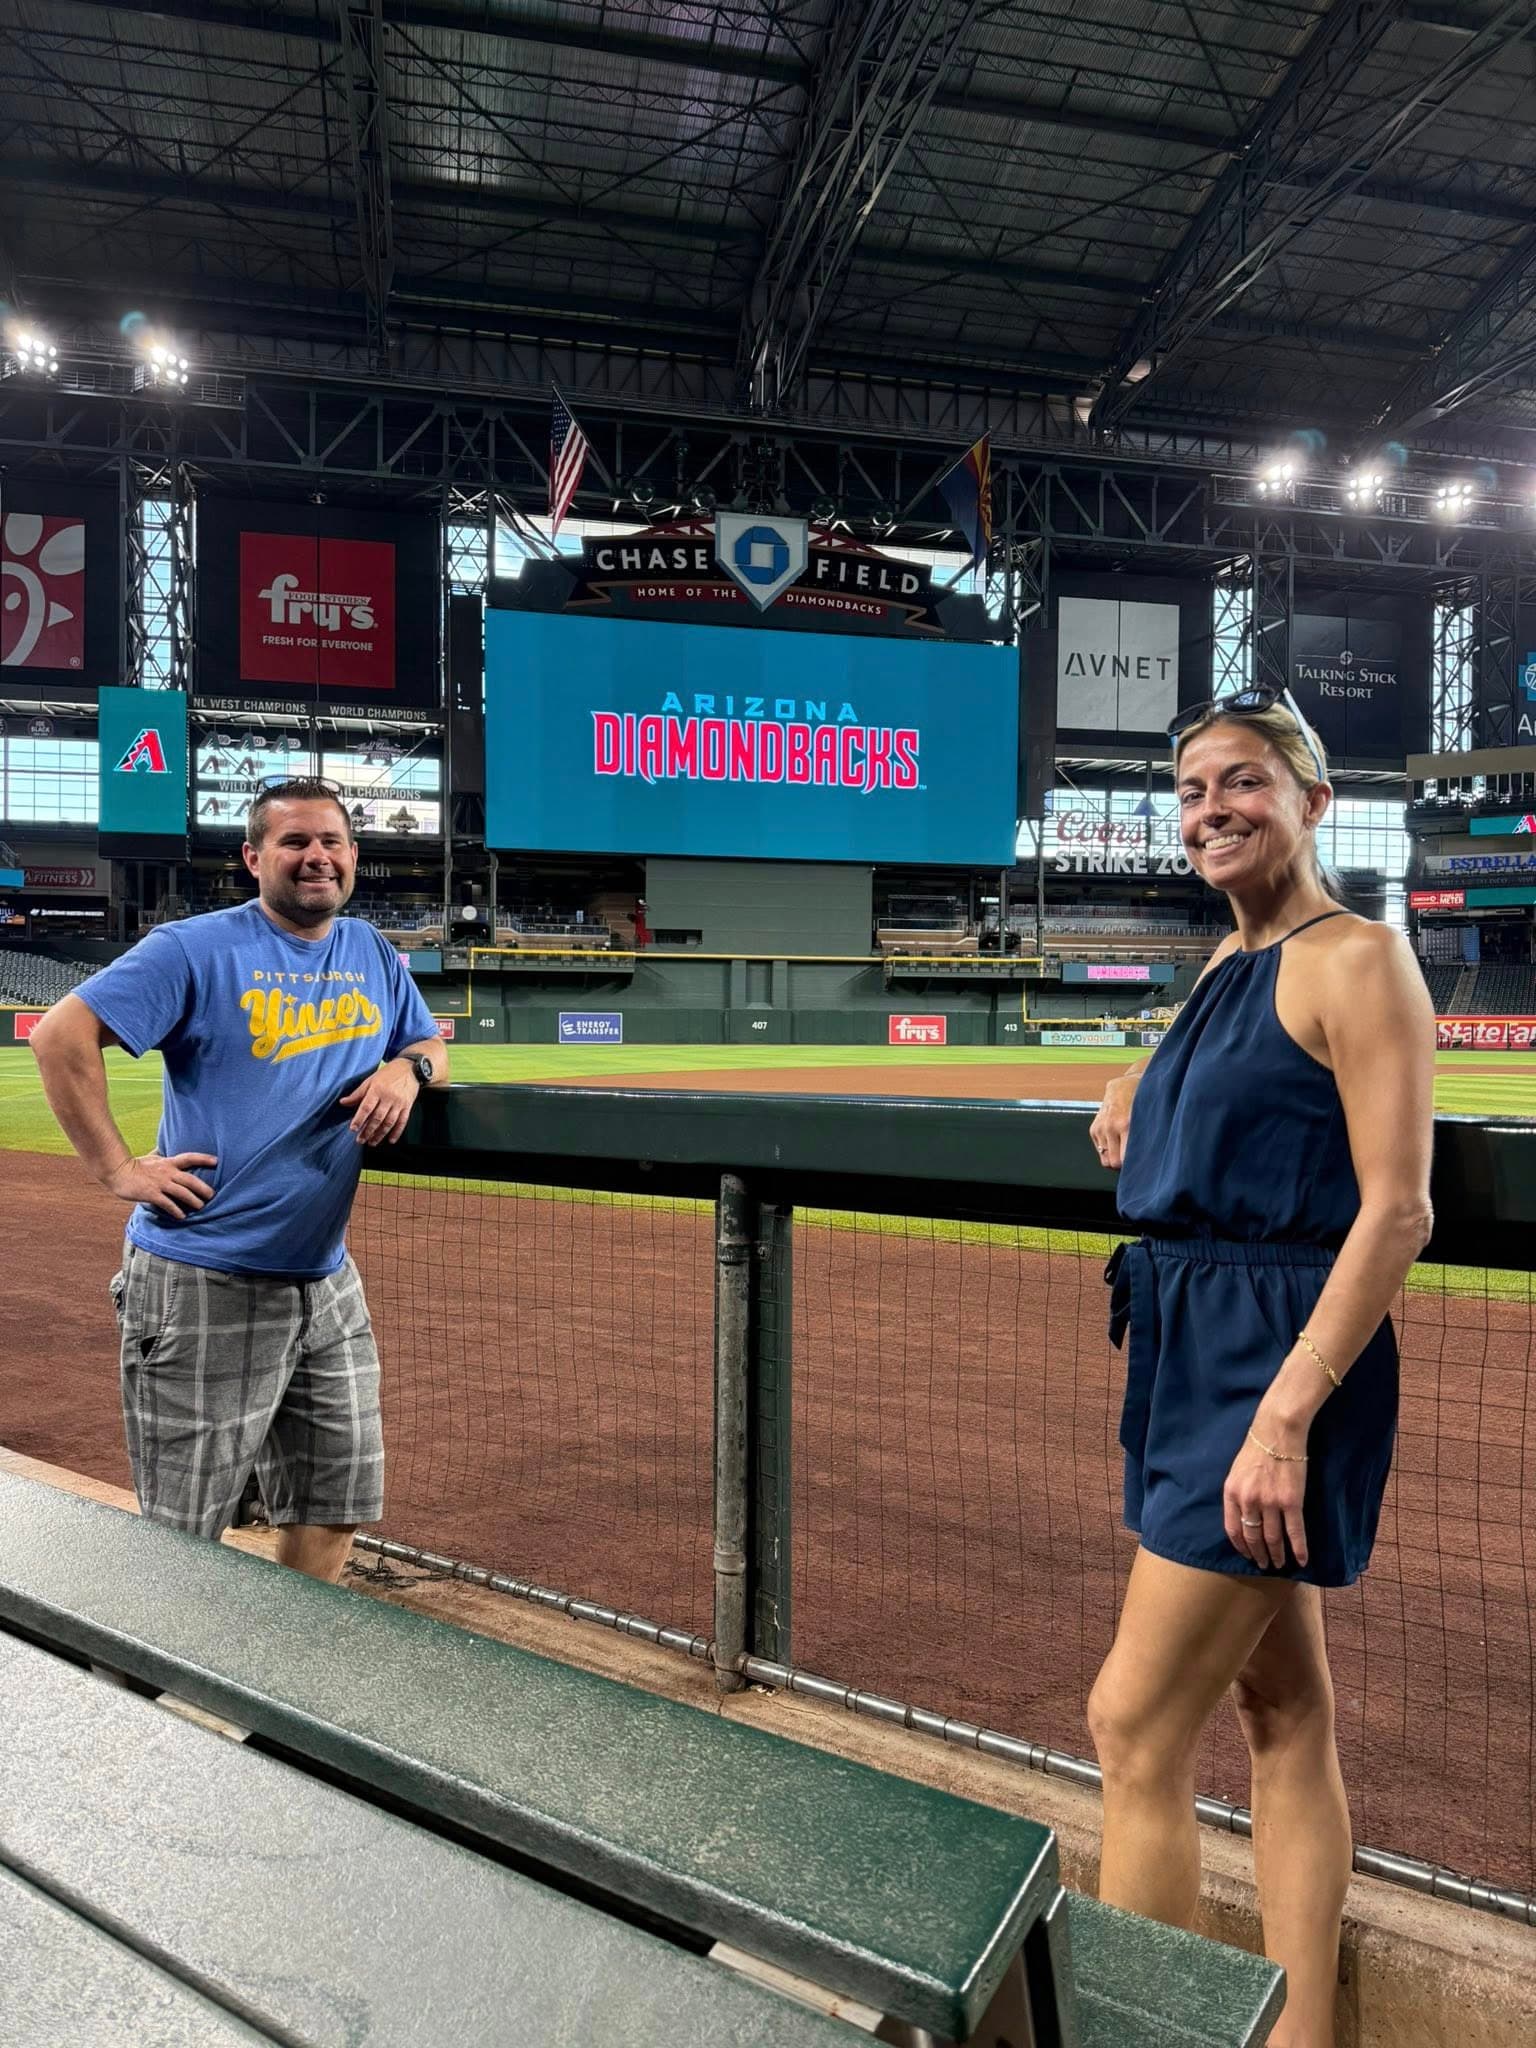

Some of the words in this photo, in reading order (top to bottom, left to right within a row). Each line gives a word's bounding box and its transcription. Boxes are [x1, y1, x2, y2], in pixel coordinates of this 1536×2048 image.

[596, 548, 708, 571] CHASE
[816, 558, 921, 595] FIELD
[258, 573, 375, 632] fry's
[637, 587, 676, 598] HOME
[686, 588, 702, 598] OF
[713, 589, 737, 599] THE
[786, 593, 882, 615] DIAMONDBACKS
[262, 635, 294, 646] FRESH
[297, 638, 317, 648] FOR
[321, 639, 373, 651] EVERYONE
[1064, 652, 1171, 681] AVNET
[1295, 663, 1355, 681] TALKING
[1359, 668, 1397, 684] STICK
[1319, 681, 1373, 699] RESORT
[193, 697, 206, 707] NL
[210, 698, 240, 710] WEST
[243, 700, 307, 713] CHAMPIONS
[329, 705, 363, 717] WORLD
[367, 708, 427, 721] CHAMPIONS
[661, 691, 858, 723] ARIZONA
[590, 710, 919, 795] DIAMONDBACKS
[220, 780, 247, 792] WILD
[250, 781, 266, 793] CA
[357, 786, 421, 800] CHAMPIONS
[1056, 808, 1142, 843] Coors
[1055, 850, 1148, 873] STRIKE
[1156, 853, 1201, 875] ZO
[34, 874, 78, 883] FITNESS
[253, 969, 366, 984] PITTSURGH
[239, 987, 383, 1062] Yinzer
[479, 1019, 495, 1027] 413
[751, 1021, 768, 1030] 407
[896, 1018, 939, 1041] fry's
